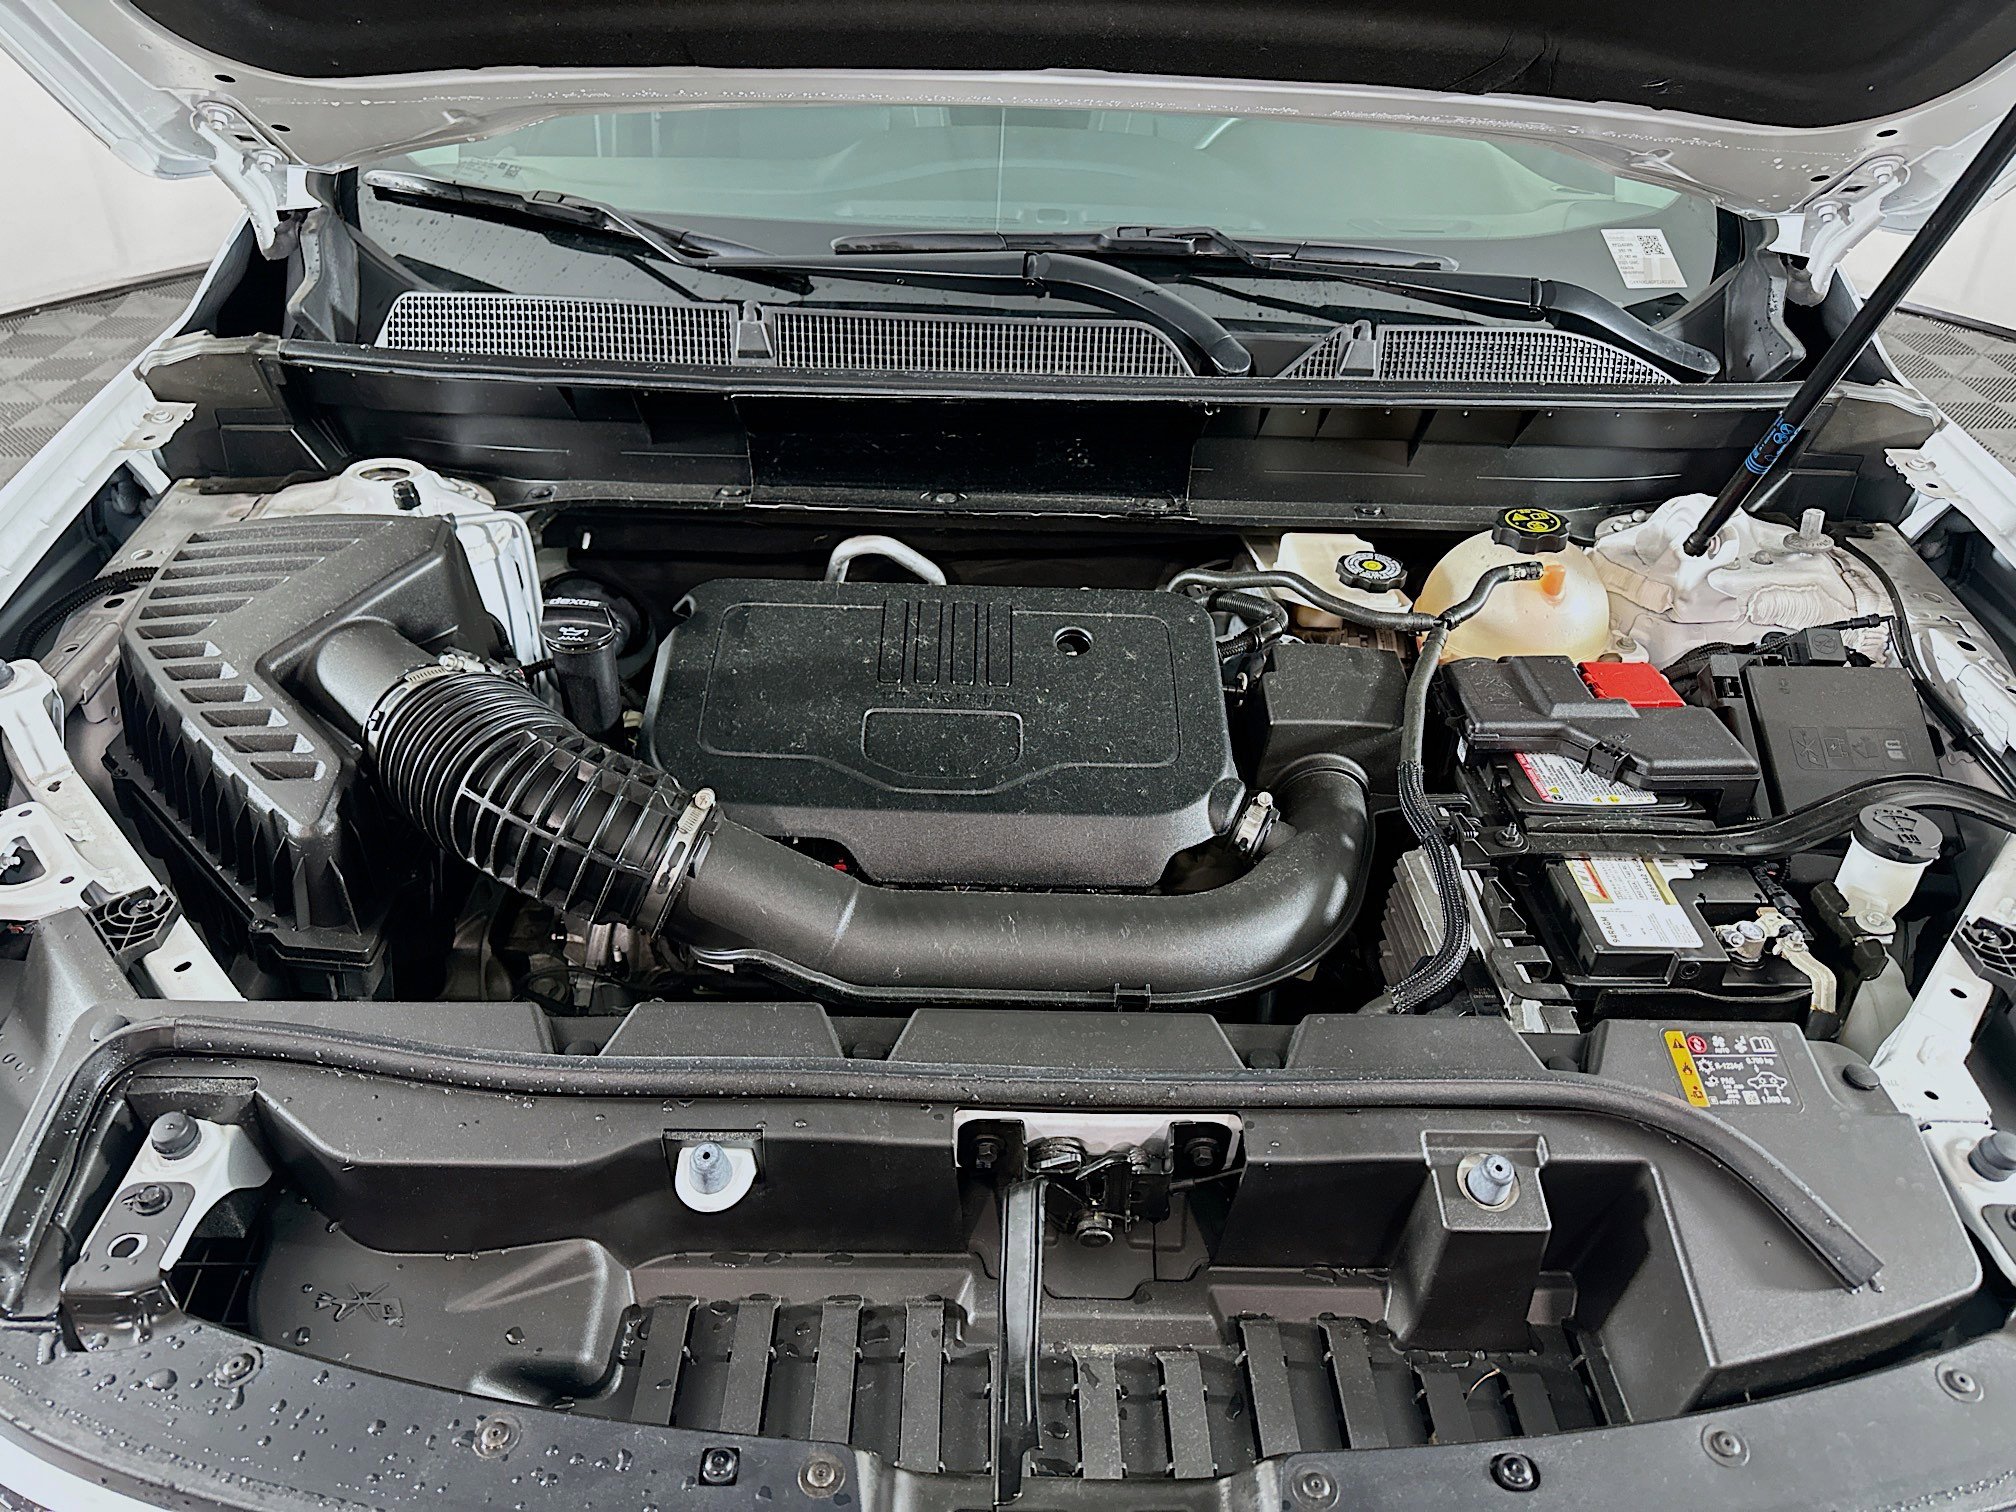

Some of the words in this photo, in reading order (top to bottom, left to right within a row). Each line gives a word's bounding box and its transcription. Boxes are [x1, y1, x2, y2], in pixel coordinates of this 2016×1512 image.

[549, 597, 601, 607] dexos
[1764, 1057, 1775, 1066] kg
[1781, 1096, 1792, 1105] kg
